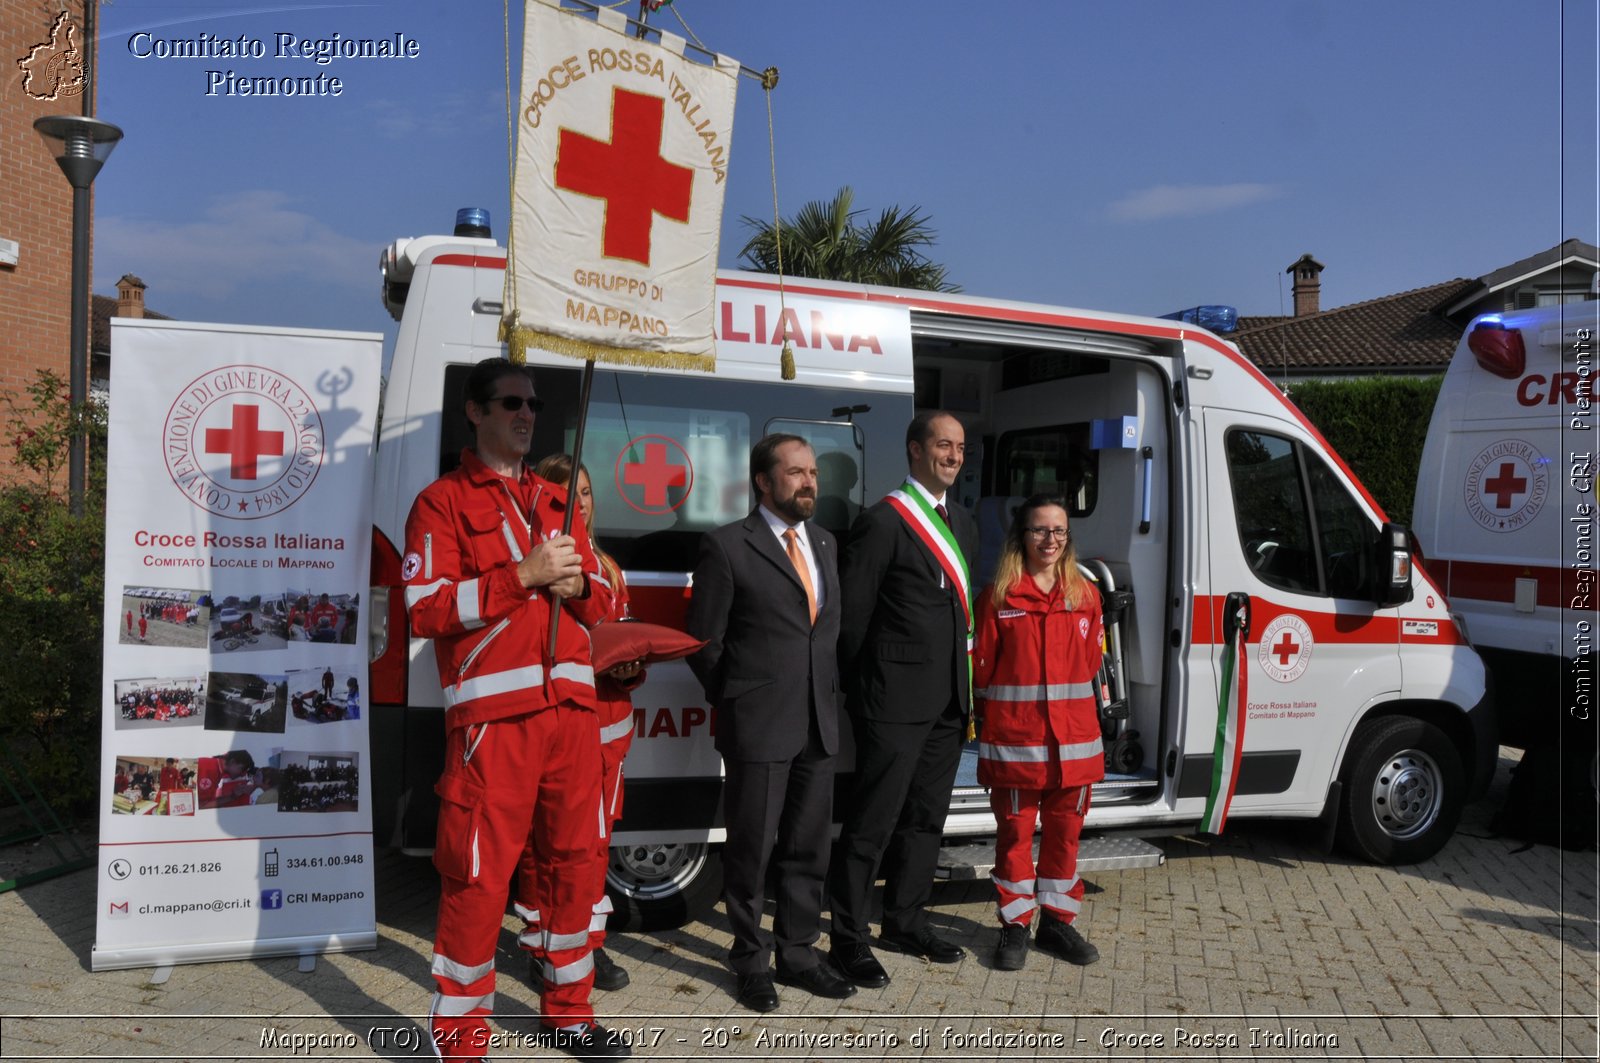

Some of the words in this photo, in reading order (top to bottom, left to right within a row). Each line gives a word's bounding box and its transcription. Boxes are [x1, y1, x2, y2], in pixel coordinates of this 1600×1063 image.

[524, 56, 586, 128] CROCE
[588, 48, 665, 83] ROSSA
[669, 72, 725, 185] ITALIANA
[574, 268, 647, 298] GRUPPO
[651, 283, 663, 302] DI
[566, 299, 668, 337] MAPPANO
[713, 301, 883, 355] LIANA
[191, 382, 214, 404] DI
[215, 371, 291, 404] GINEVRA
[288, 400, 309, 419] 22
[170, 400, 230, 511] CONVENZIONE
[288, 422, 317, 489] AGOSTO
[1481, 450, 1492, 464] DI
[1492, 442, 1533, 461] GINEVRA
[255, 485, 289, 512] 1864
[1467, 462, 1496, 527] CONVENZIONE
[1525, 474, 1545, 515] AGOSTO
[134, 530, 196, 547] Croce
[203, 531, 267, 549] Rossa
[275, 533, 344, 550] Italiana
[1248, 702, 1268, 710] Croce
[1279, 711, 1285, 719] di
[1287, 711, 1315, 719] Mappano
[139, 862, 222, 876] 011.26.21.826
[286, 854, 364, 869] 334.61.00.948
[139, 899, 251, 915] cl.mappano@cri.it
[286, 893, 308, 904] CRI
[312, 890, 364, 904] Mappano
